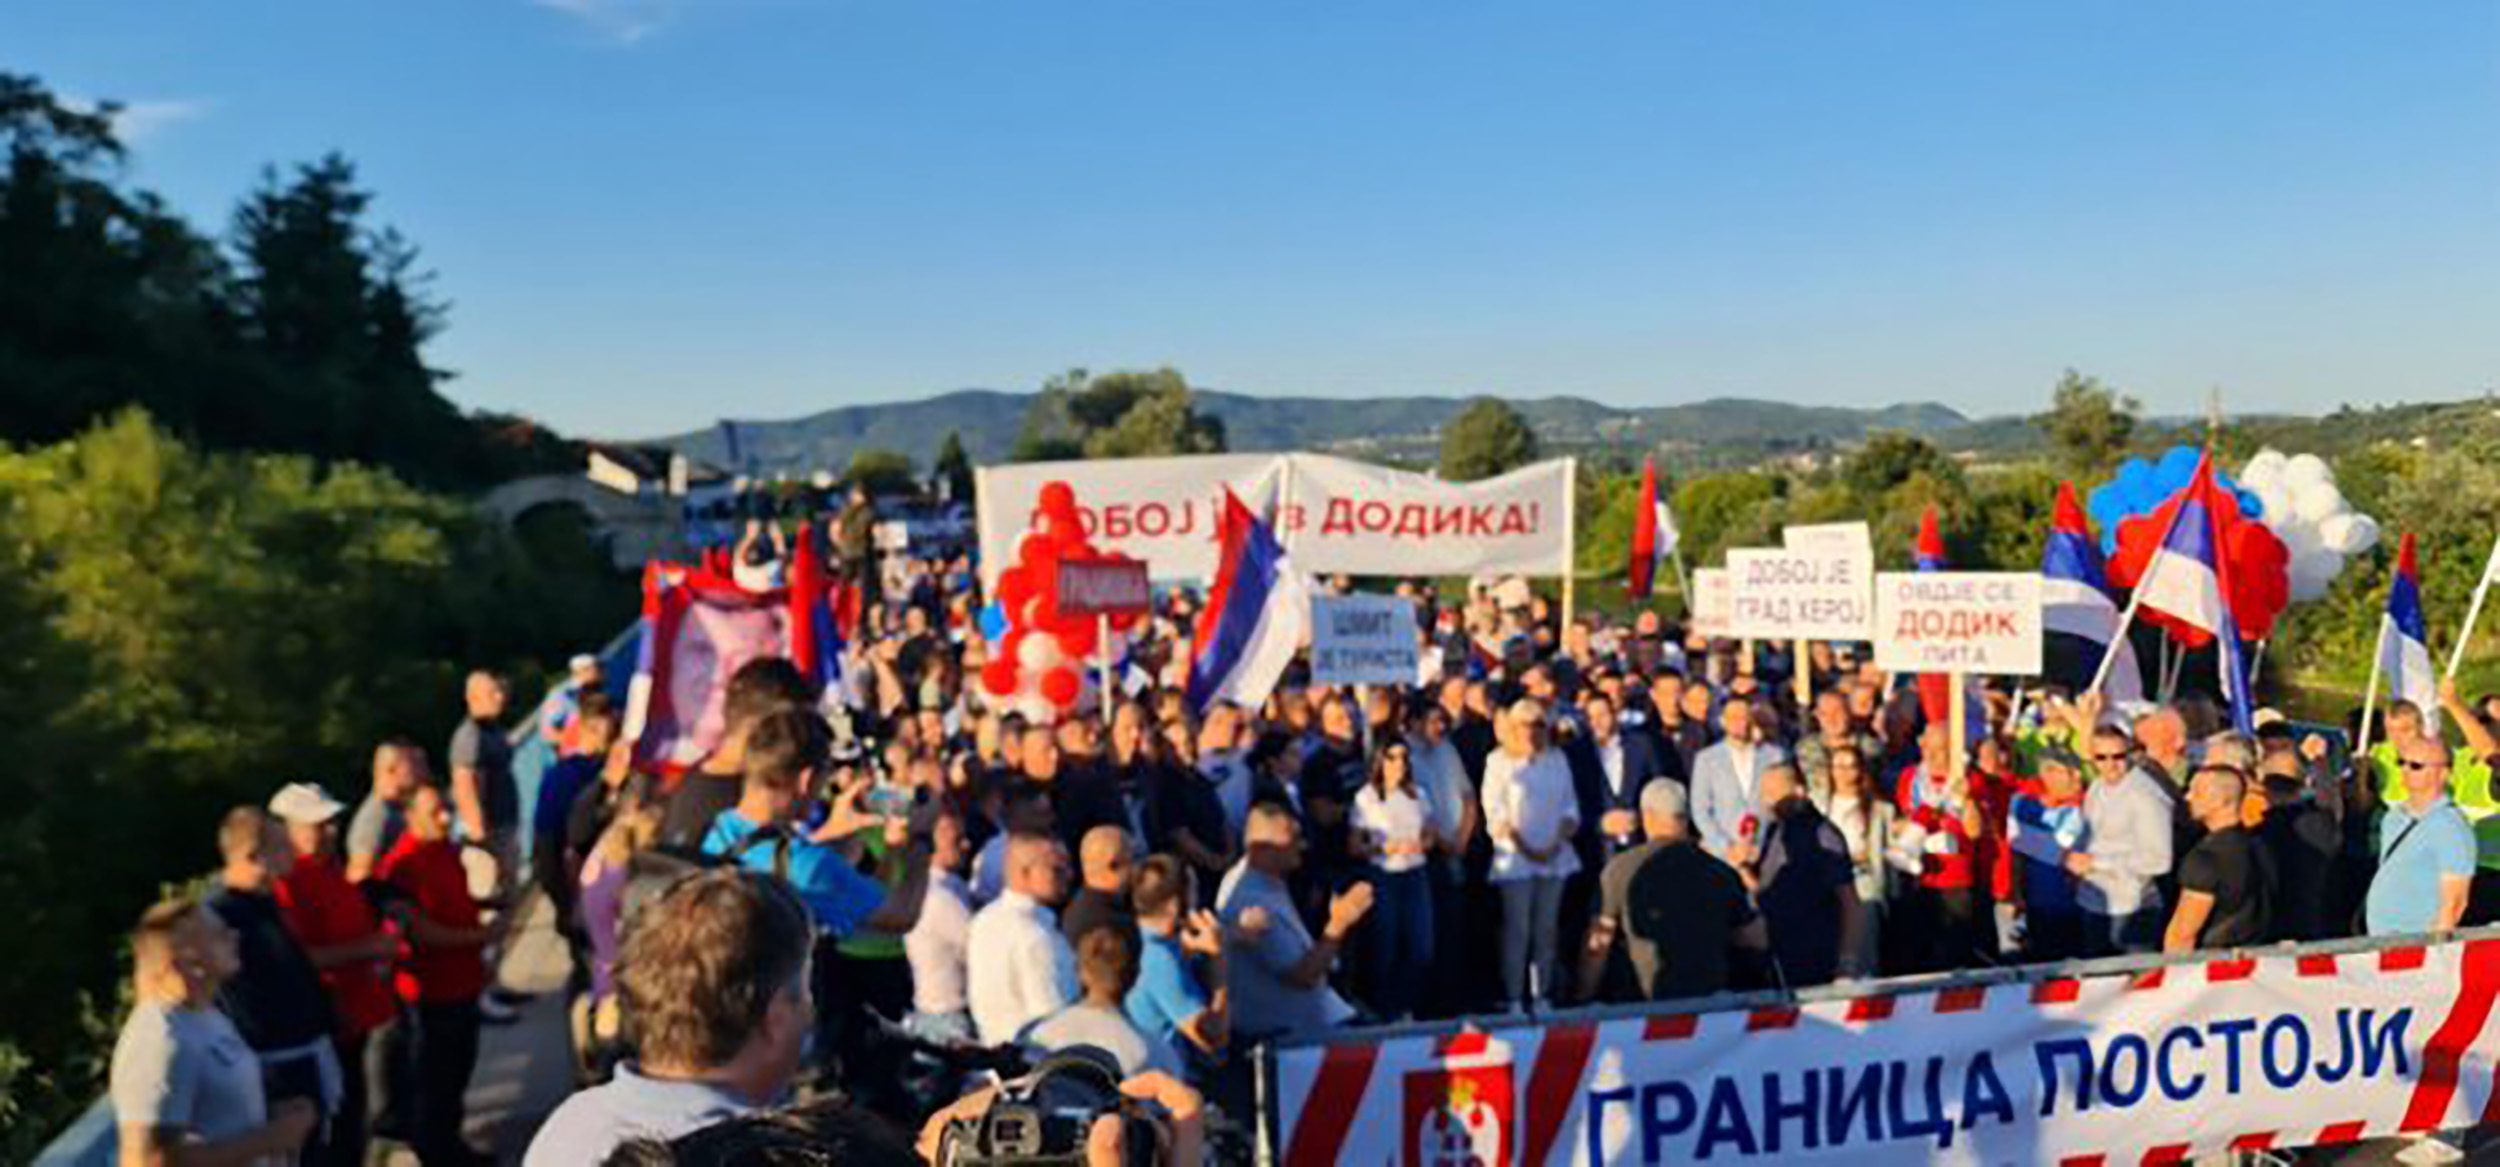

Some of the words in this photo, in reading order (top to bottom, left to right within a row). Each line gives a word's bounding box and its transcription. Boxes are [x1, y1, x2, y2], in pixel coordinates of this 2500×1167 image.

[1320, 498, 1540, 538] ДОДИКА!
[1748, 558, 1819, 585] ДОБОЈ
[1825, 558, 1850, 584] ЈЕ
[1736, 597, 1791, 628] ГРАД
[1894, 609, 2019, 641] ДОДИК
[1588, 1050, 2014, 1167] ГРАНИЦА
[2033, 1006, 2413, 1118] ПОСТОЈИ
